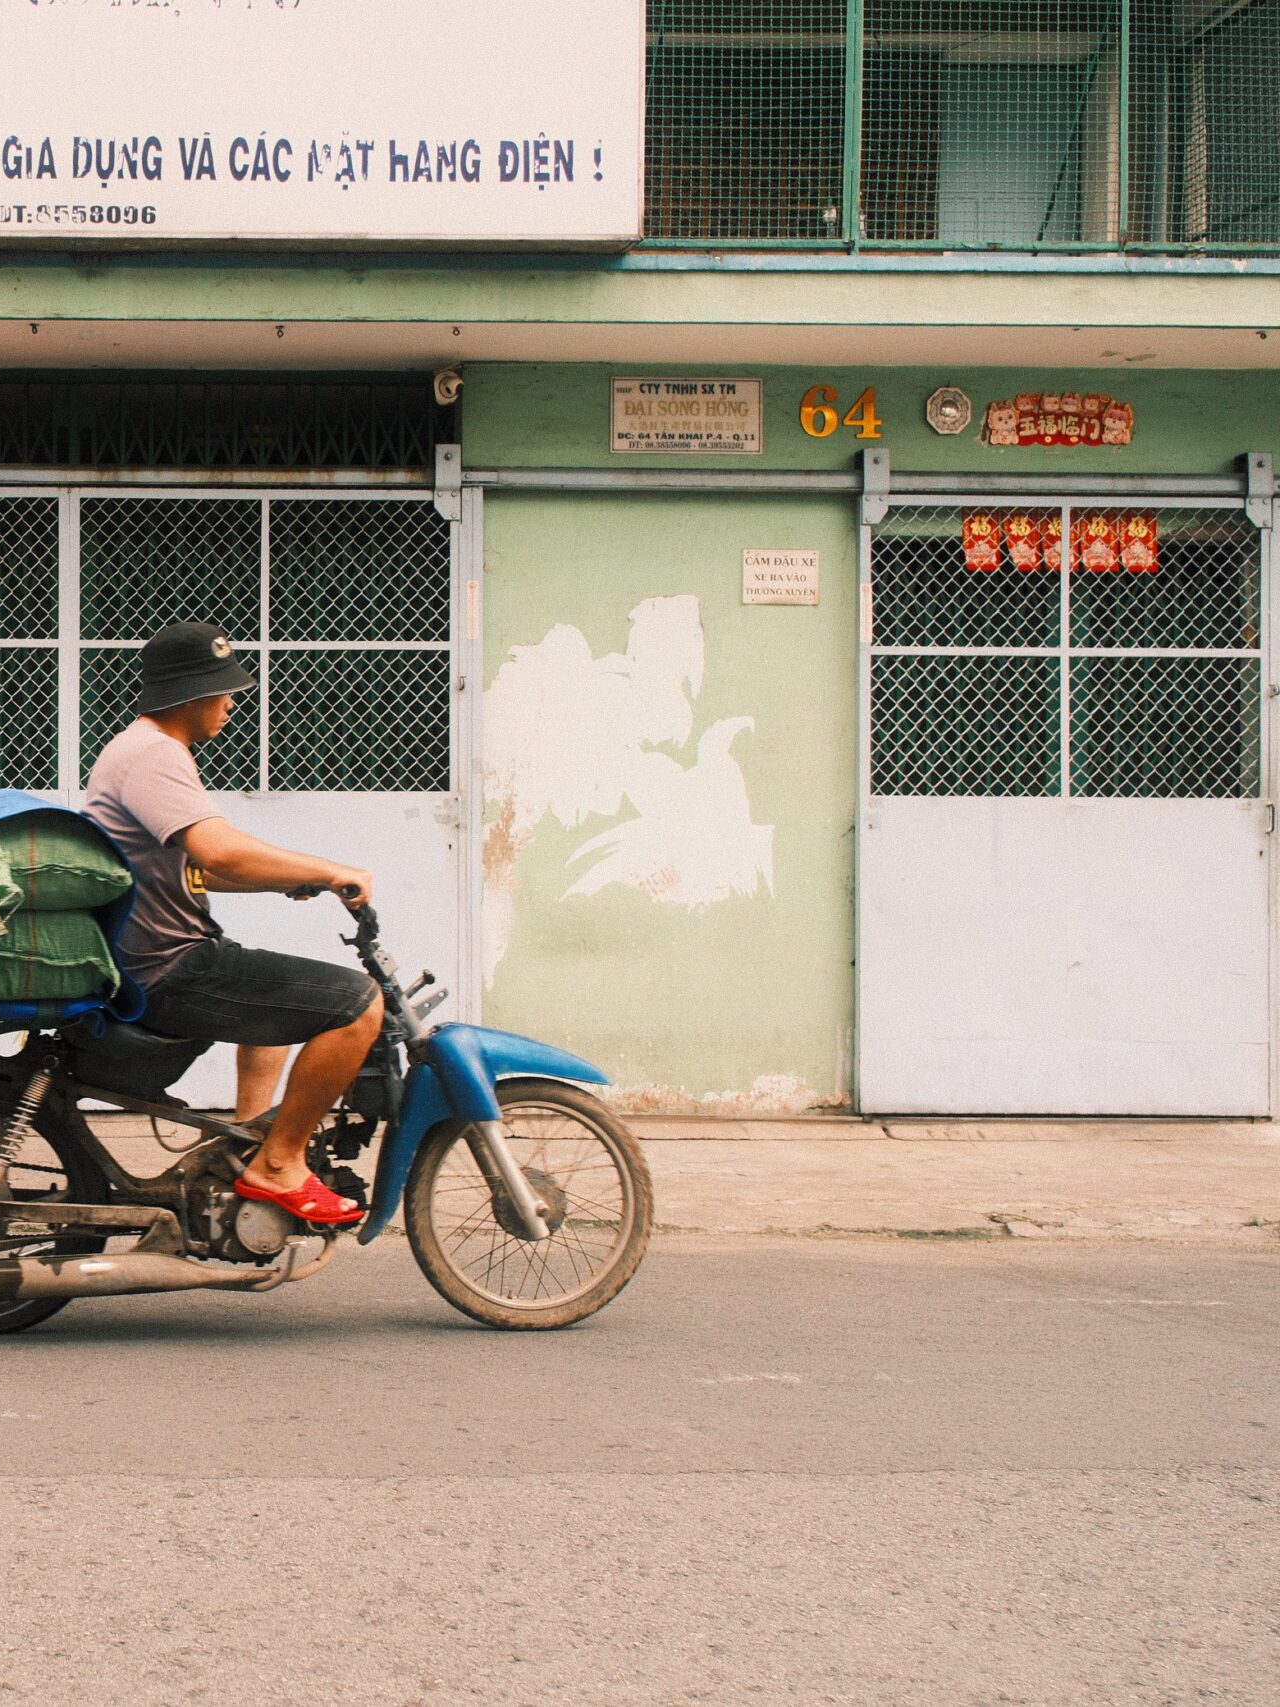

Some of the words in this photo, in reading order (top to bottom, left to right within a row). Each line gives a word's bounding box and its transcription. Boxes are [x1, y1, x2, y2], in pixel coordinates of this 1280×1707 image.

[72, 135, 163, 189] DỤNG
[228, 130, 293, 182] CÁC
[498, 131, 574, 191] ĐIỆN
[639, 383, 660, 394] CTY
[665, 383, 697, 395] TNHH
[701, 384, 715, 395] SX
[719, 384, 737, 395] TM
[799, 384, 883, 439] 64
[1019, 414, 1100, 440] 五福临门
[678, 432, 703, 440] KHAI
[745, 553, 770, 566] CẤM
[801, 557, 817, 567] XE
[754, 573, 766, 581] XE
